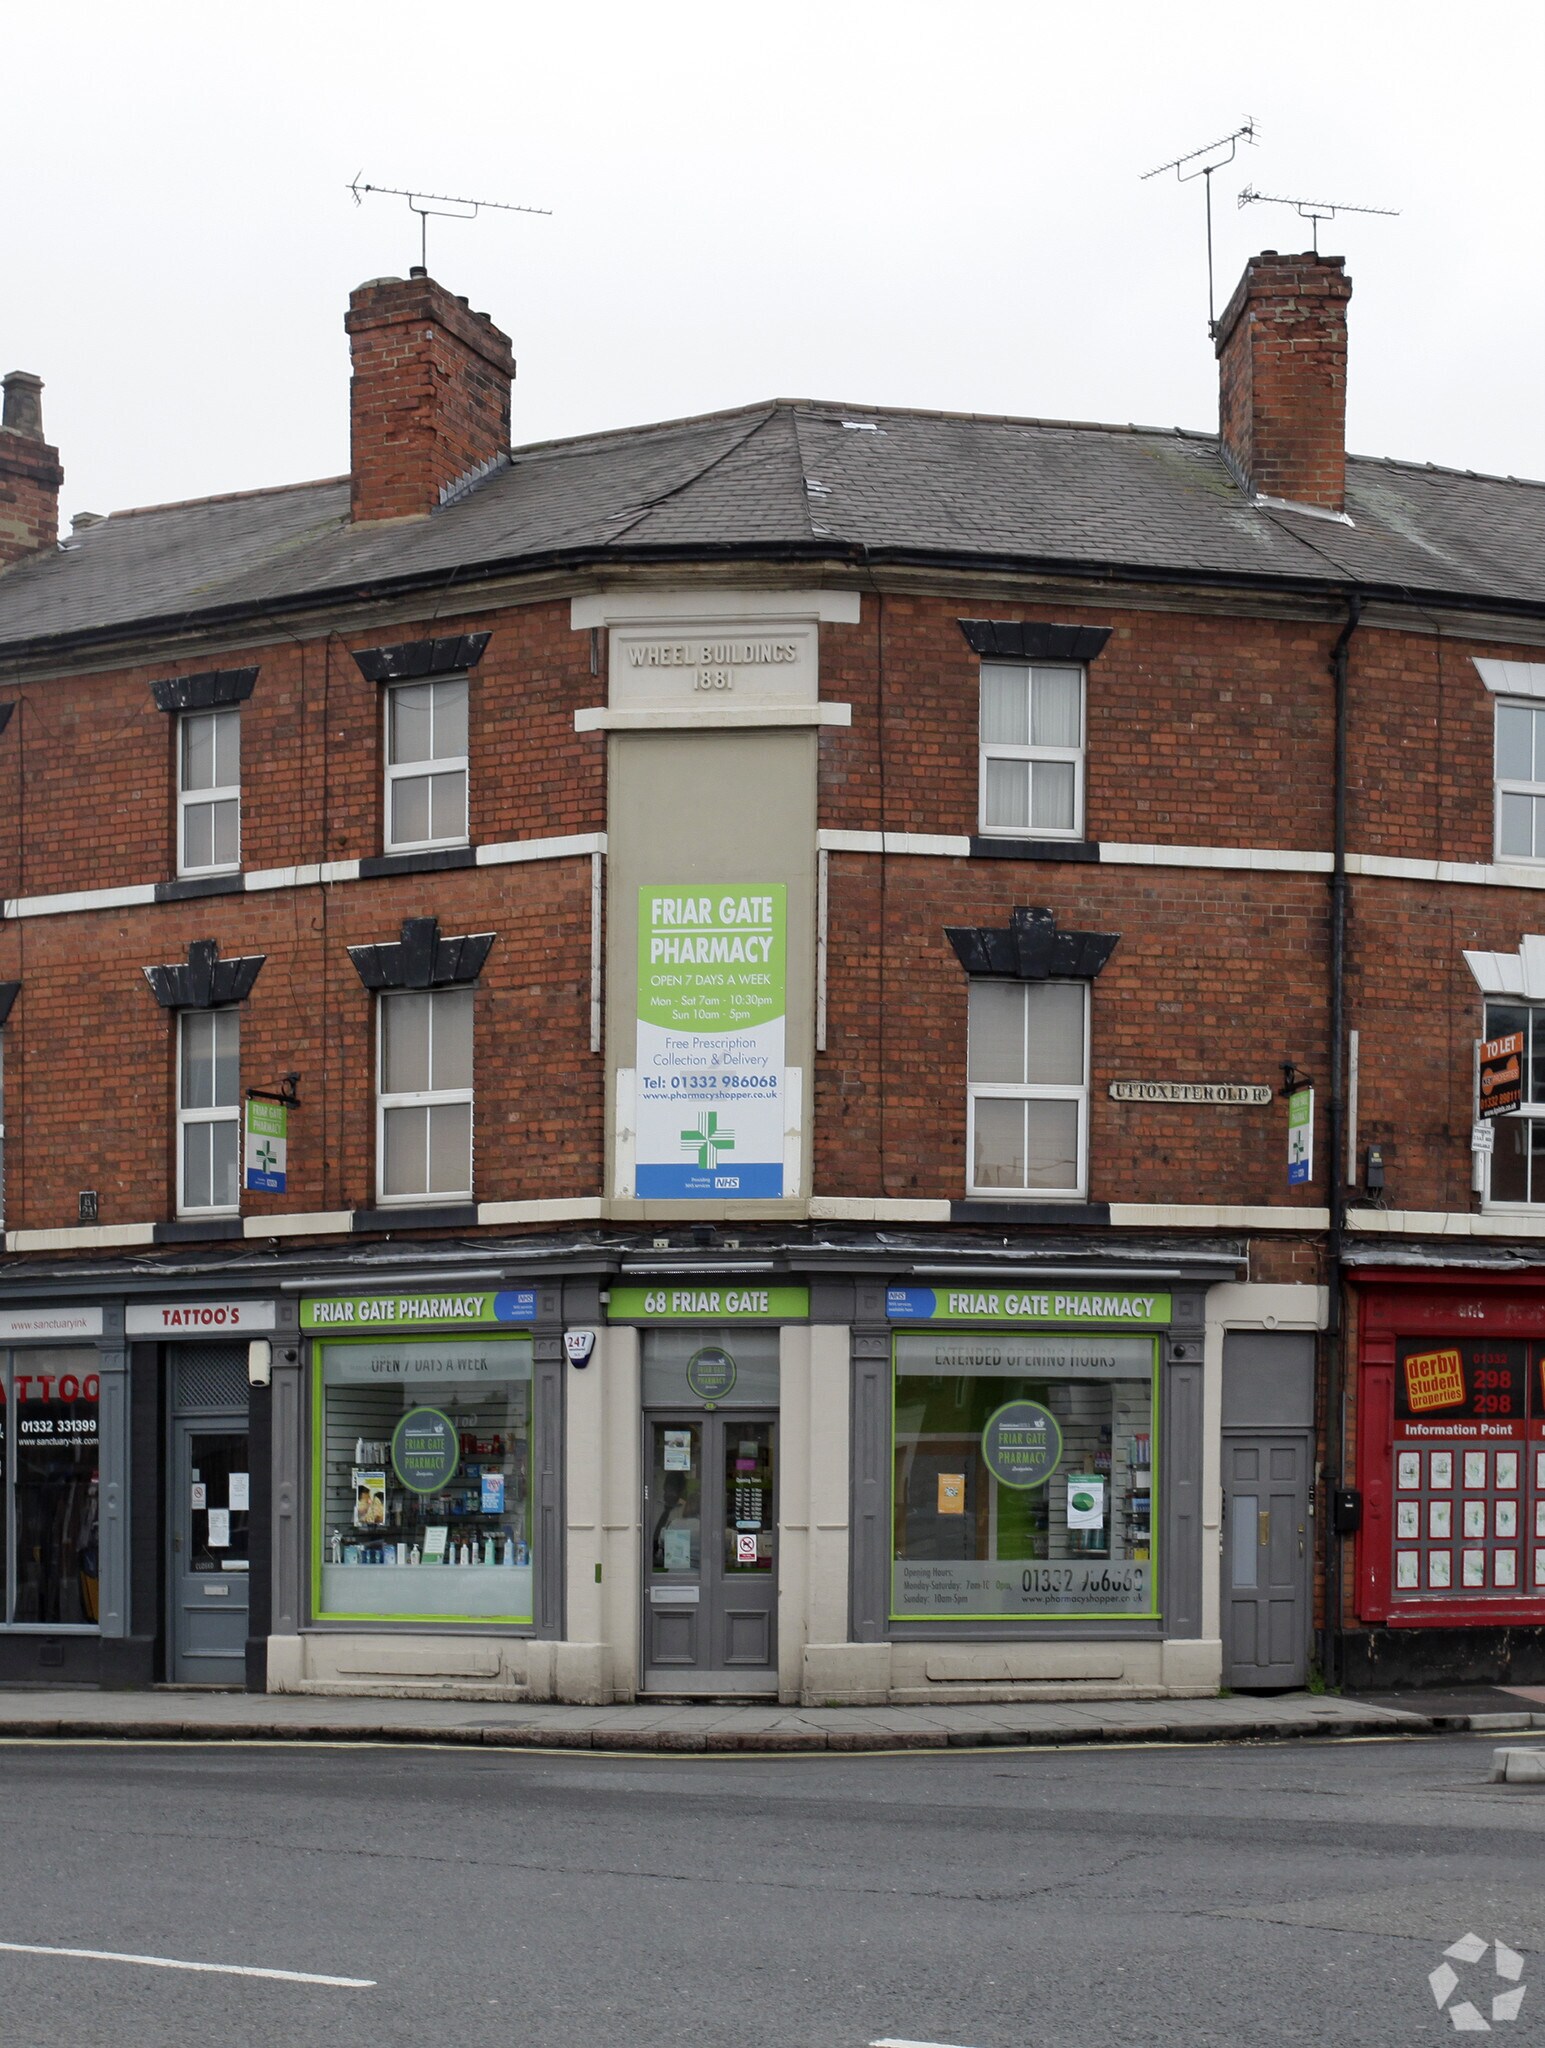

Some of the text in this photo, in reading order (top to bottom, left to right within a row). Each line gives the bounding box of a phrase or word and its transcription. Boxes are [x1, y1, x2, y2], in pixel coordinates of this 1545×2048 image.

[629, 643, 797, 667] WHEEL BUILDINGS
[694, 669, 733, 691] 1881
[652, 896, 773, 924] FRIAR GATE
[651, 936, 773, 964] PHARMACY
[651, 973, 771, 986] OPEN 7 DAYS A WEEK
[650, 996, 671, 1006] Mon
[681, 995, 696, 1006] Sat
[699, 995, 720, 1006] 7am
[731, 995, 773, 1007] 10:30pm
[672, 1009, 690, 1020] Sun
[694, 1009, 720, 1019] 10am
[729, 1008, 750, 1021] 5pm
[665, 1037, 756, 1051] Free Prescription
[1486, 1035, 1516, 1058] TO LET
[653, 1053, 769, 1067] Collection & Delivery
[643, 1075, 777, 1088] Tel: 01332 986068
[642, 1090, 777, 1101] www.pharmacyshopper.co.uk
[1115, 1083, 1214, 1100] UTTOXETER
[1217, 1086, 1248, 1101] OLD
[715, 1177, 739, 1188] NHS
[644, 1291, 769, 1313] 68 FRIAR GATE
[949, 1293, 1155, 1318] FRIAR GATE PHARMACY
[162, 1305, 240, 1326] TATTOO'S
[313, 1297, 484, 1322] FRIAR GATE PHARMACY
[11, 1317, 88, 1331] www.sanctuaryink
[568, 1336, 586, 1347] 247
[935, 1347, 1001, 1366] EXTENDED
[1473, 1353, 1508, 1364] 01332
[1408, 1355, 1457, 1380] derby
[1411, 1374, 1460, 1395] student
[1473, 1369, 1511, 1389] 298
[1412, 1389, 1461, 1408] properties
[1473, 1394, 1511, 1413] 298
[21, 1419, 96, 1433] 01332 331399
[1405, 1423, 1512, 1436] Information Point
[18, 1437, 99, 1448] www.sanctuary-ink.com
[405, 1438, 445, 1450] FRIAR GATE
[999, 1433, 1046, 1445] FRIAR GATE
[404, 1457, 445, 1469] PHARMACY
[999, 1452, 1046, 1464] PHARMACY
[904, 1568, 931, 1578] Opening
[1022, 1569, 1073, 1592] 01332
[1021, 1593, 1143, 1605] www.pharmacyshopper.couk
